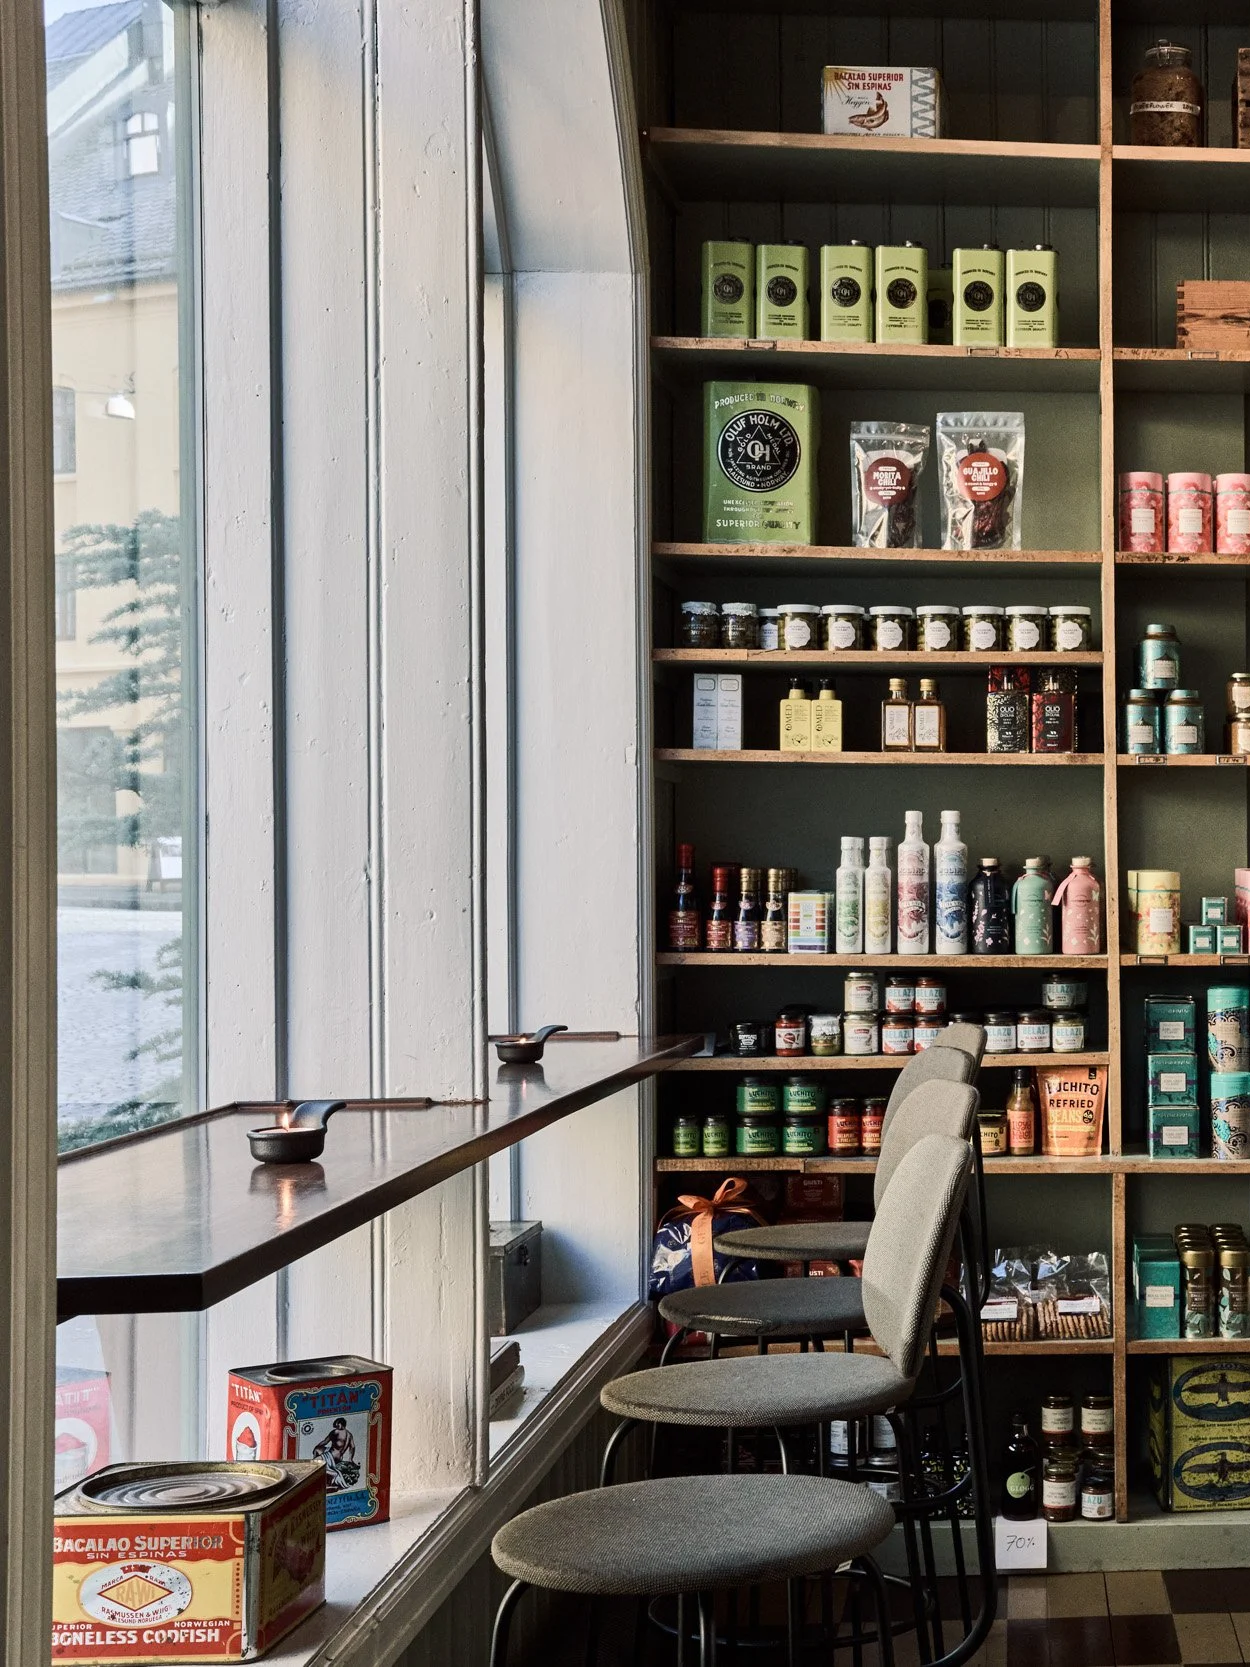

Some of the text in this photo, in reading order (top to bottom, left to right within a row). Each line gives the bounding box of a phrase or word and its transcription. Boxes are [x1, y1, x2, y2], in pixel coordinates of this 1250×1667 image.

[834, 72, 904, 82] BACALAO SUPERIOR
[847, 82, 892, 90] SIN ESPINAS
[714, 393, 754, 409] PRODUCED
[725, 414, 747, 442] OLUF
[750, 414, 780, 429] HOLM
[767, 433, 781, 454] MEDAL
[873, 472, 901, 480] MORITA
[963, 467, 998, 475] GUAJILLO
[728, 467, 756, 488] AALESUND
[716, 519, 760, 528] SUPERIOR
[1050, 1099, 1094, 1108] REFRIED
[1050, 1110, 1082, 1124] BEANS
[54, 1535, 224, 1553] BACALAO SUPERIOR
[1006, 1534, 1035, 1552] 70%
[118, 1551, 188, 1559] ESPINAS
[101, 1576, 124, 1589] MARCA
[101, 1607, 144, 1618] RASMUSSEN
[174, 1620, 230, 1628] NORWEGIAN
[143, 1629, 220, 1644] CODFISH
